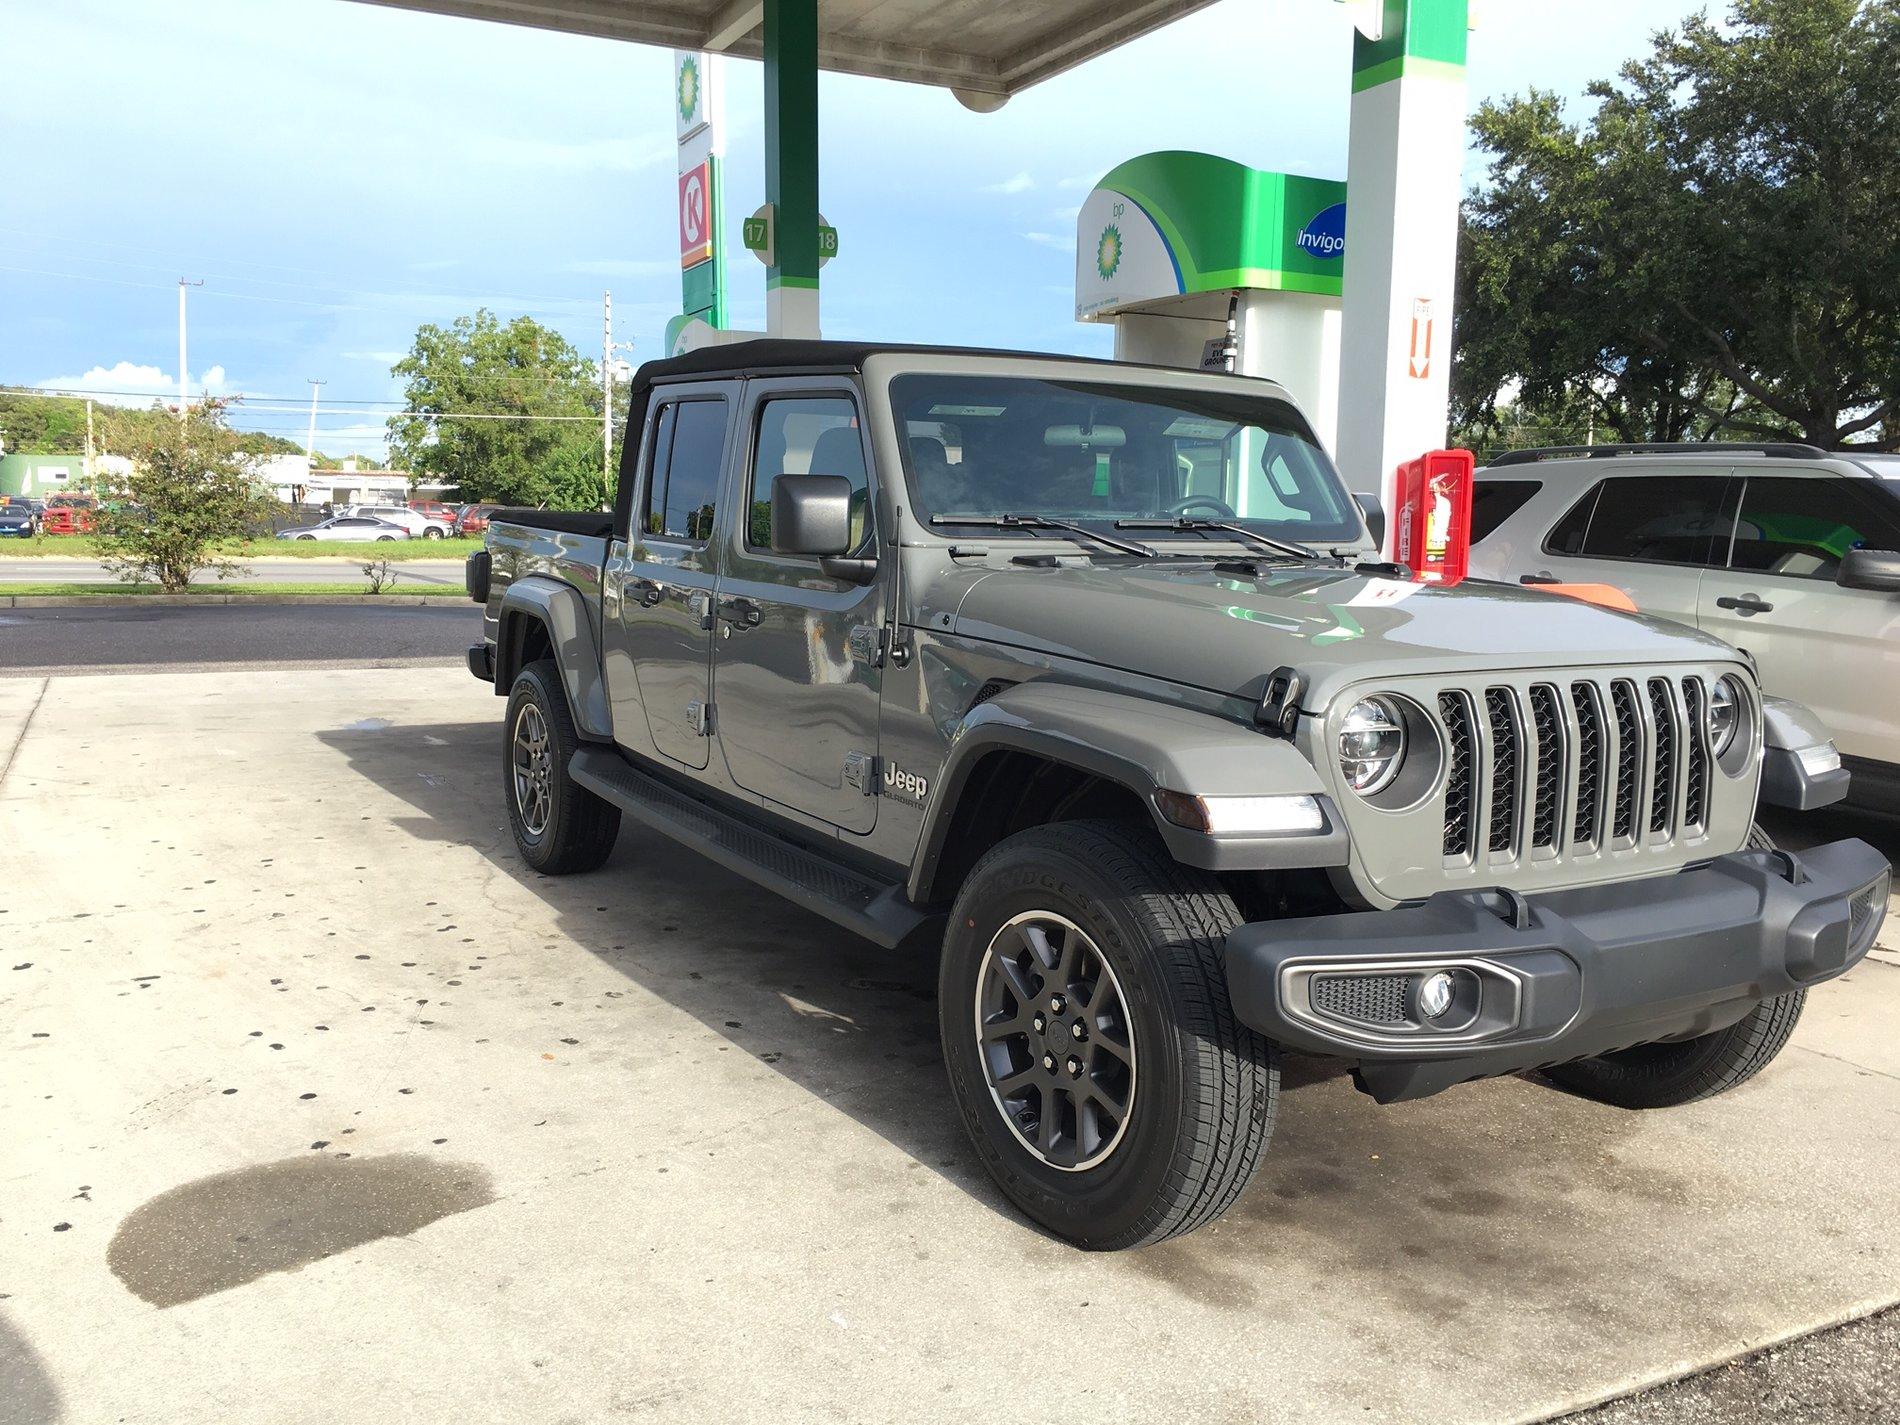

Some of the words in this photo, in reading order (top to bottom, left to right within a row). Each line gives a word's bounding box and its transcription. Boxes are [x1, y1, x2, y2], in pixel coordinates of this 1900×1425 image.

[1113, 202, 1125, 220] bp
[745, 224, 764, 242] 17
[818, 232, 836, 250] 18
[1297, 229, 1344, 253] Invigo
[884, 761, 928, 800] Jeep
